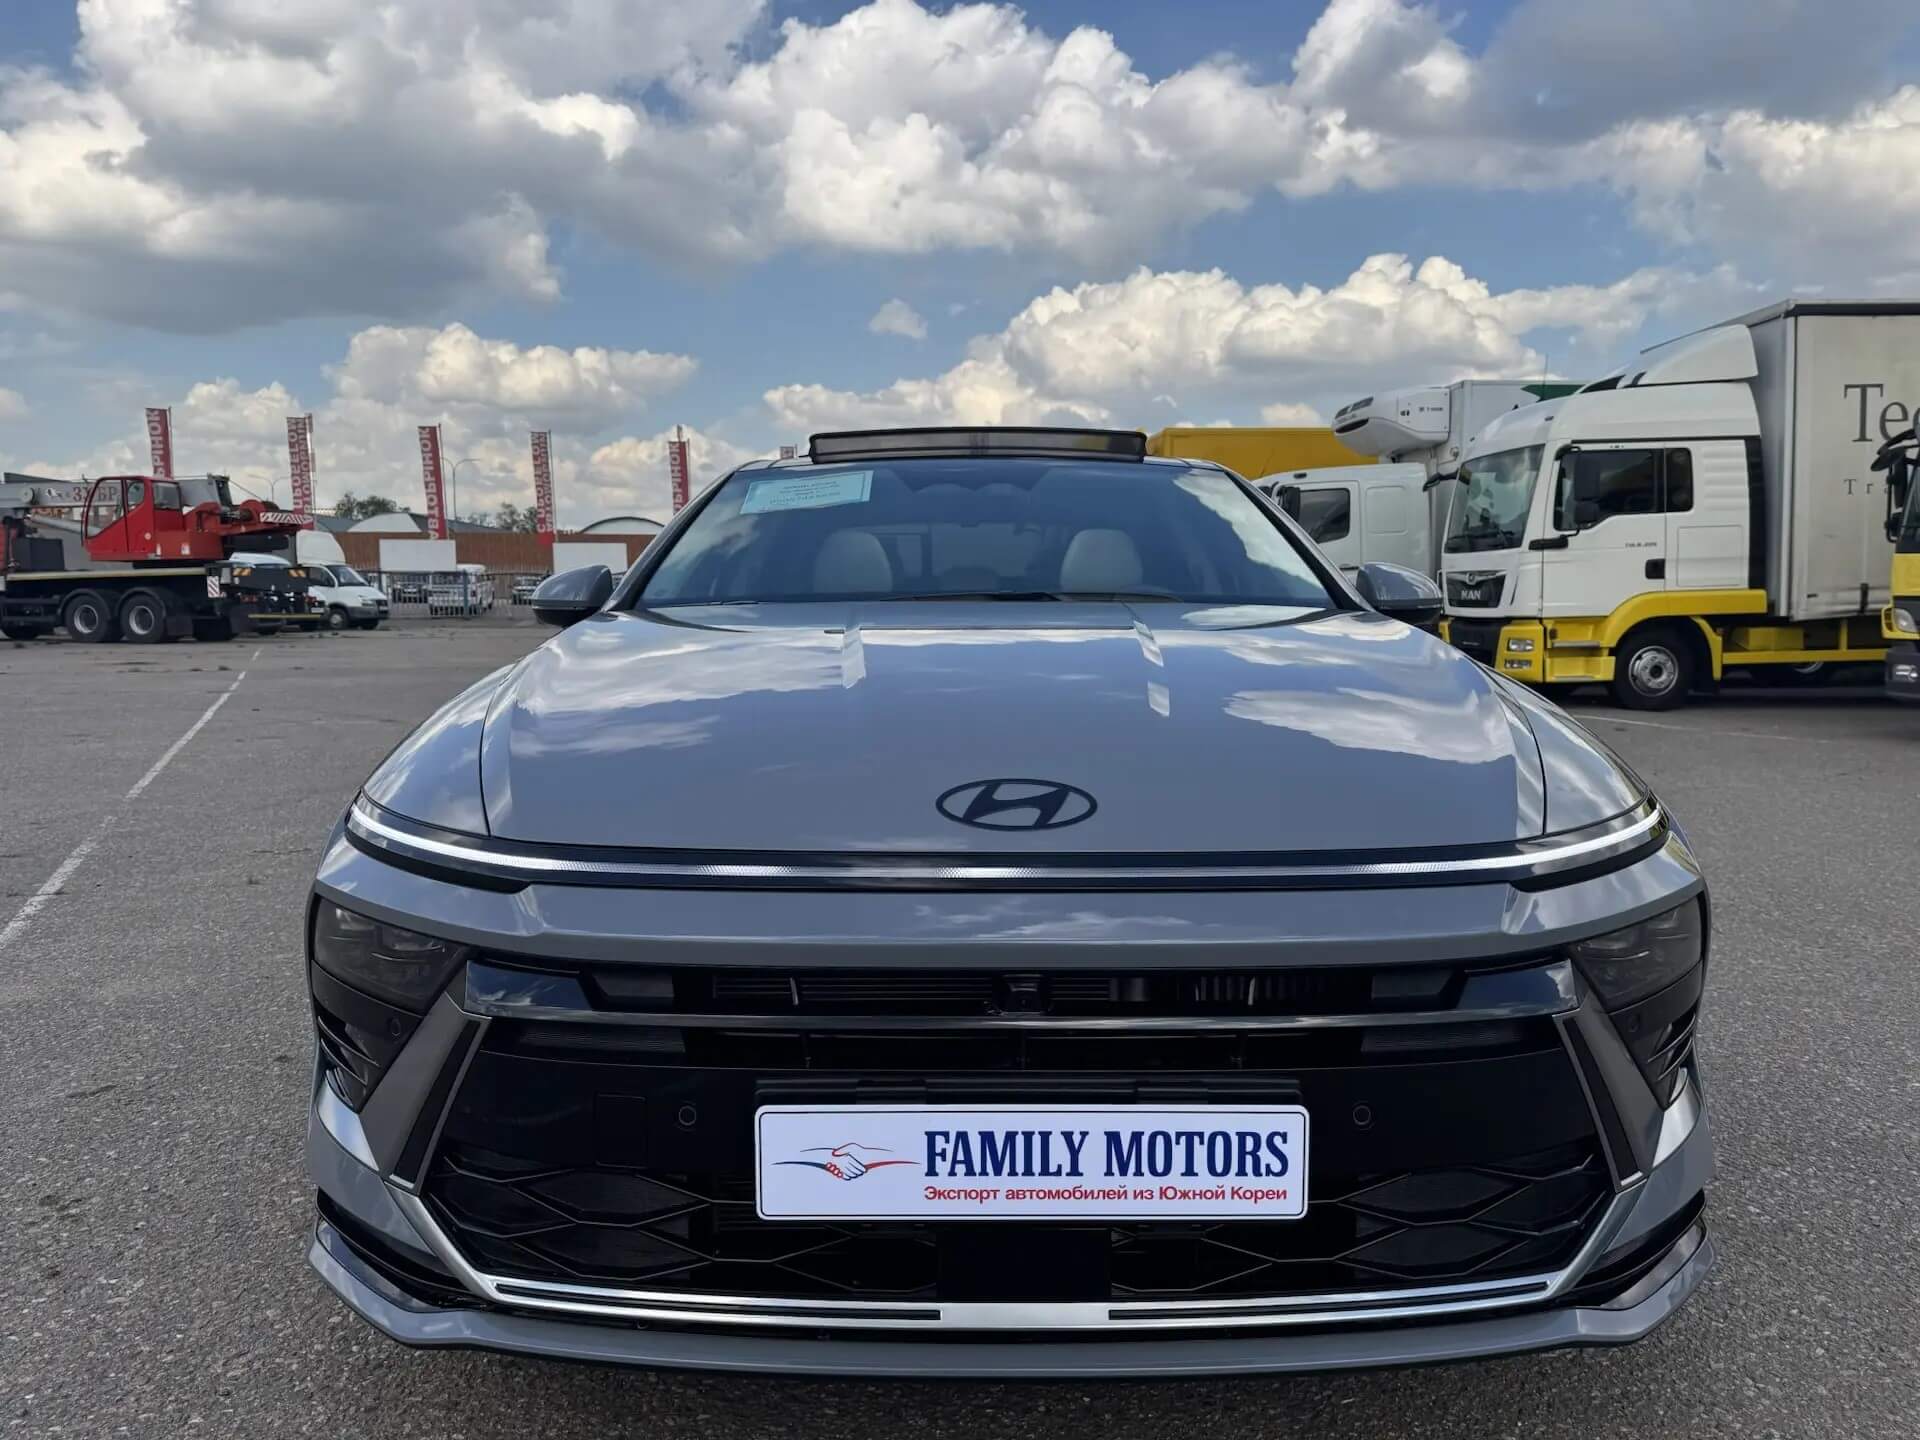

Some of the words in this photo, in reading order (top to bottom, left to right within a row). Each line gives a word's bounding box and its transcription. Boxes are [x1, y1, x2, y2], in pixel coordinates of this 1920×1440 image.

[1844, 383, 1920, 443] Te
[1844, 479, 1889, 495] Tr
[1461, 590, 1481, 601] MAN
[924, 1131, 1089, 1177] FAMILY
[1104, 1130, 1289, 1177] MOTORS
[924, 1186, 1000, 1204] Экспорт
[1005, 1184, 1128, 1200] автомобилей
[1133, 1189, 1154, 1200] из
[1159, 1184, 1226, 1200] Южной
[1230, 1186, 1287, 1204] Кореи
